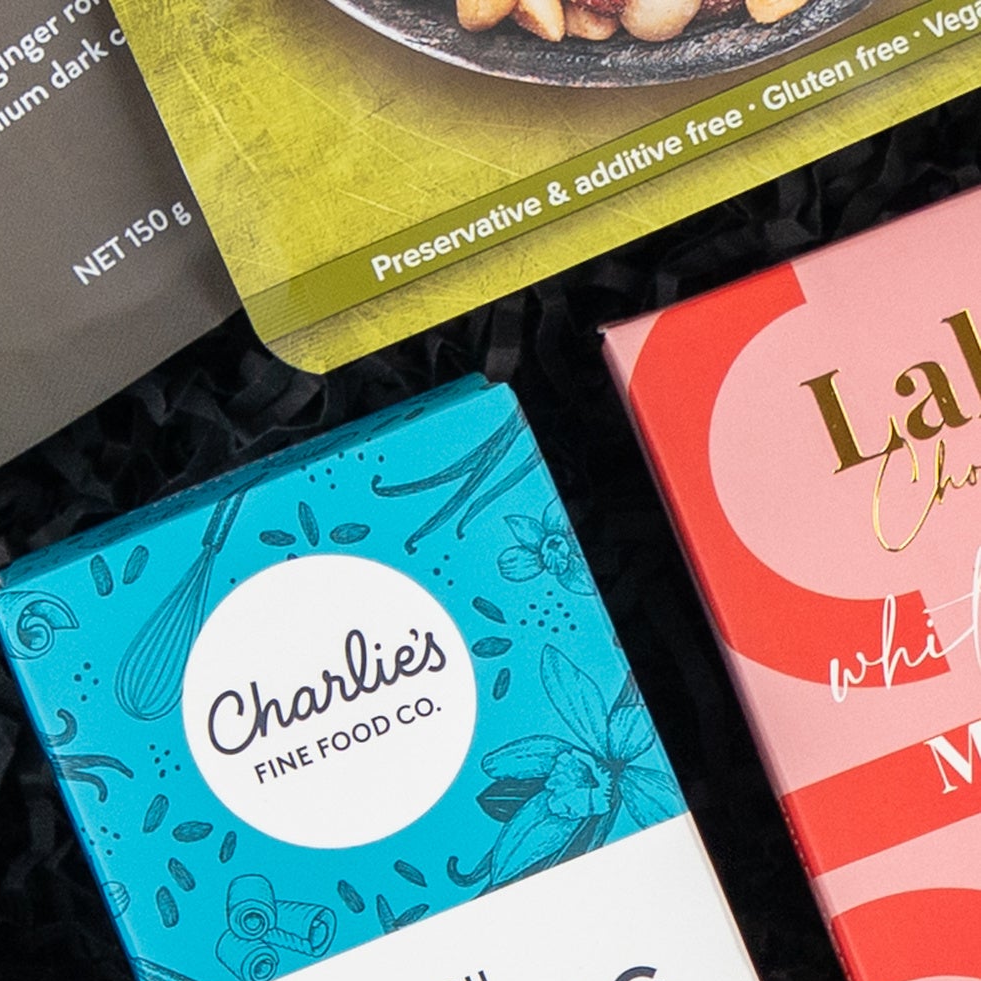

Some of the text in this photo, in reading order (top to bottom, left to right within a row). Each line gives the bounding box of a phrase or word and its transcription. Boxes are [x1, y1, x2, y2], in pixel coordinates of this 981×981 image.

[63, 0, 100, 23] ro
[51, 38, 109, 90] dark
[371, 192, 543, 283] Preservative
[547, 180, 571, 206] &
[574, 135, 684, 196] additive
[685, 105, 745, 147] free
[762, 59, 855, 112] Gluten
[855, 33, 910, 72] free
[72, 200, 192, 286] NET 150 g
[207, 628, 447, 756] Charlie's
[253, 697, 442, 784] FINE FOOD CO.
